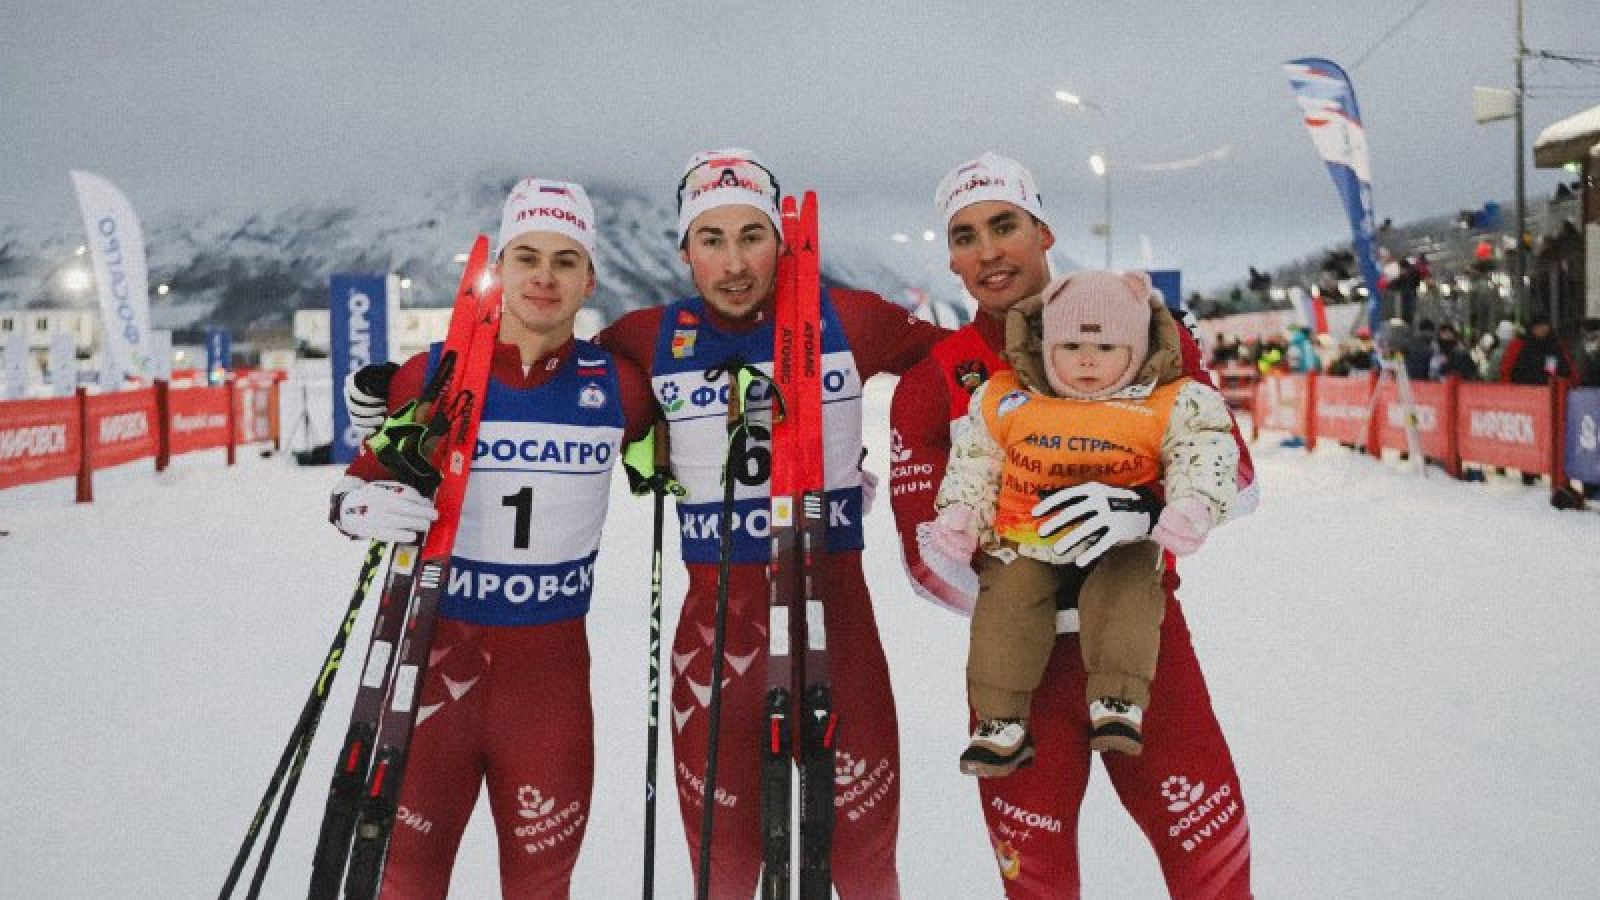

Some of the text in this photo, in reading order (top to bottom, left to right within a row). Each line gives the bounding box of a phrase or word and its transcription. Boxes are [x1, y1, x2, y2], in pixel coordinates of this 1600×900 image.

[514, 207, 587, 232] ЛУКОЙЛ
[733, 425, 771, 487] 6
[501, 486, 533, 549] 1
[513, 801, 581, 837] ФОСАГРО
[524, 814, 585, 854] BIVIUM
[991, 796, 1062, 833] ЛУКОЙЛ
[1168, 783, 1231, 838] ФОСАГРО
[1181, 799, 1239, 853] BIVIUM
